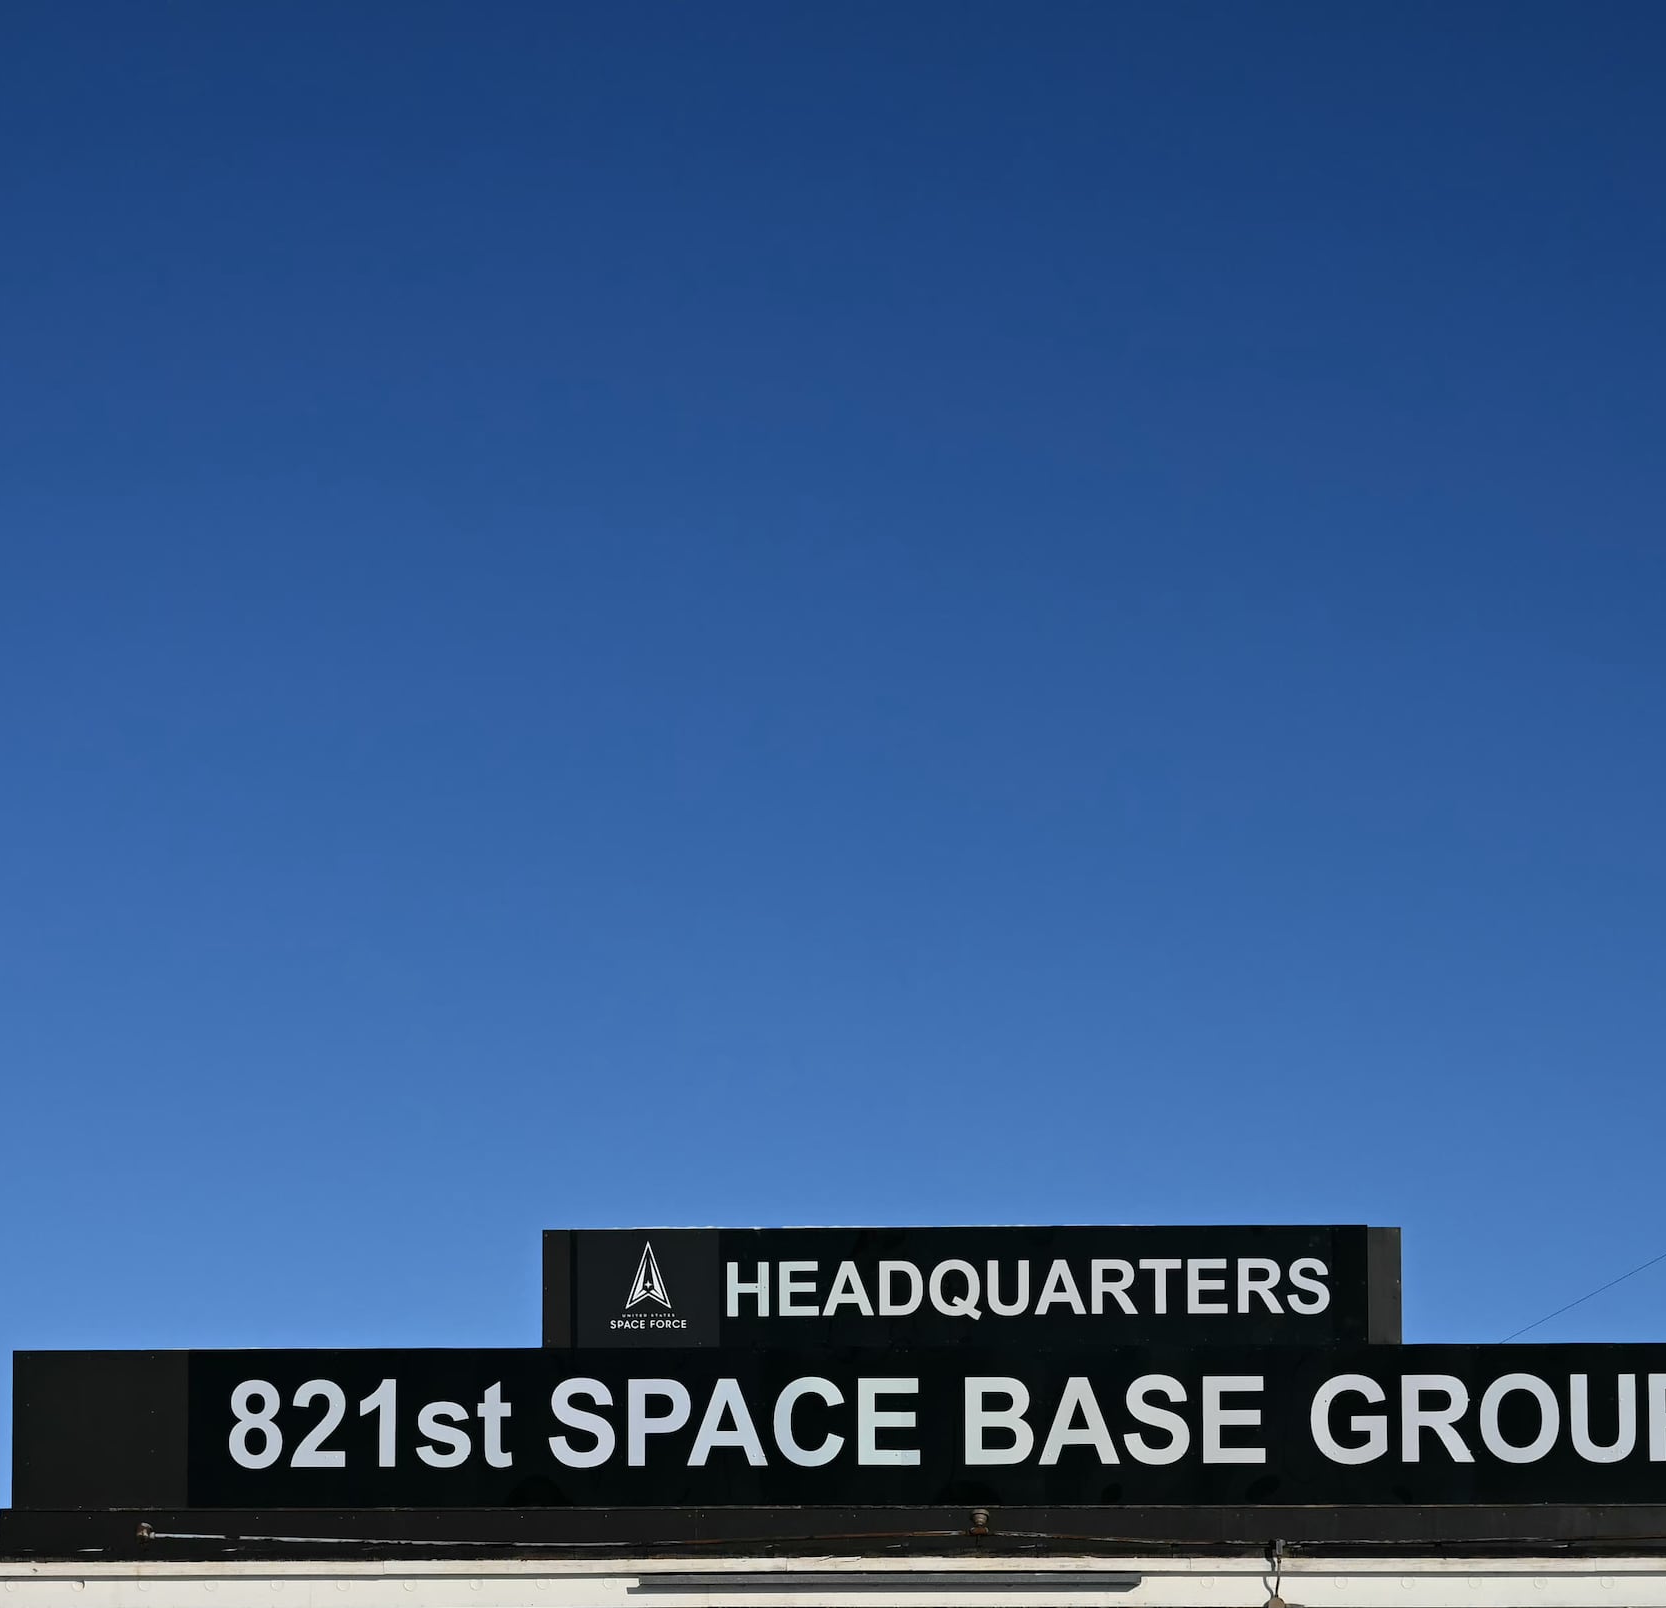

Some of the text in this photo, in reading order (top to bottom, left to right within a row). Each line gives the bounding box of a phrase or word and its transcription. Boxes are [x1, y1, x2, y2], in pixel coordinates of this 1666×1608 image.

[726, 1257, 1331, 1321] HEADQUARTERS
[610, 1319, 687, 1330] SPACE FORCE
[228, 1378, 513, 1470] 821st
[548, 1376, 921, 1469] SPACE
[964, 1373, 1267, 1466] BASE
